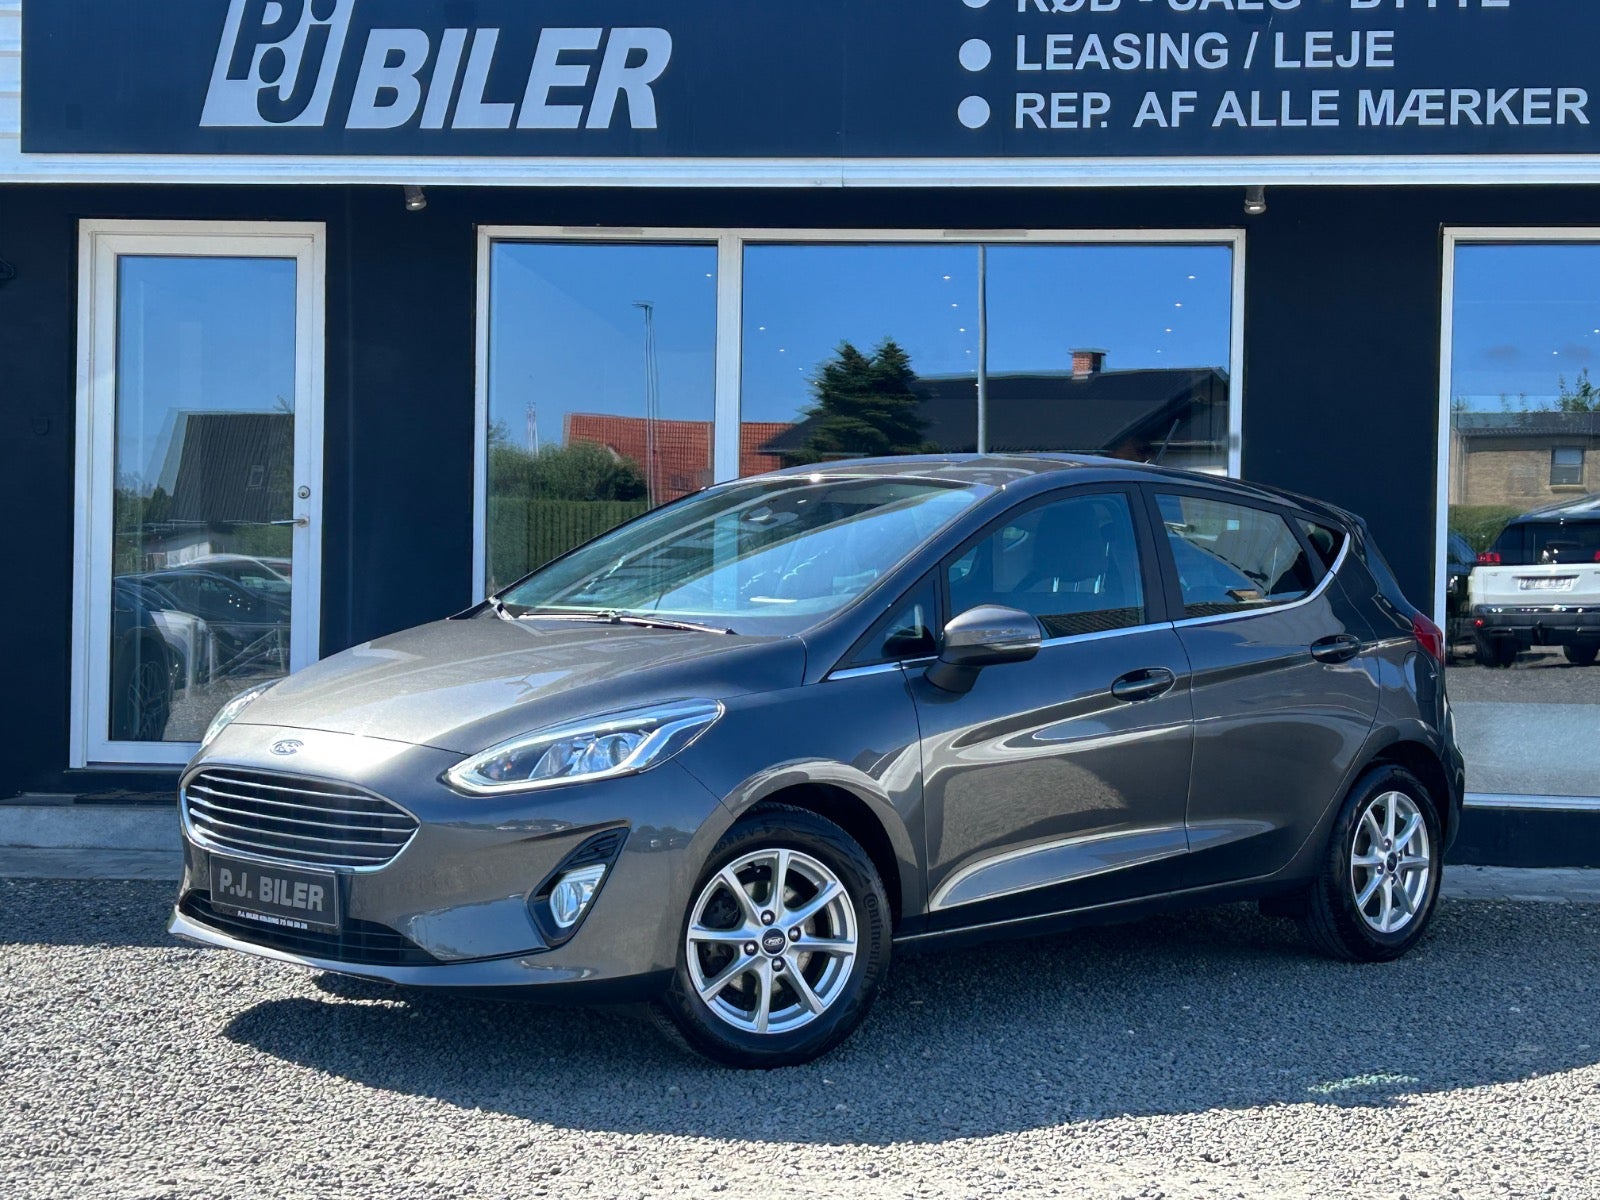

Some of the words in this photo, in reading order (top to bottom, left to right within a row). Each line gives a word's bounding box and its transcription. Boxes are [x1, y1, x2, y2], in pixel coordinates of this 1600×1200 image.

[1016, 32, 1228, 71] LEASING
[1244, 32, 1258, 69] /
[1275, 31, 1395, 69] LEJE
[345, 28, 673, 130] BILER
[1015, 92, 1110, 129] REP.
[1133, 91, 1198, 128] AF
[1212, 89, 1340, 127] ALLE
[1358, 88, 1590, 126] MÆRKER
[219, 867, 253, 899] P.J.
[259, 875, 324, 912] BILER
